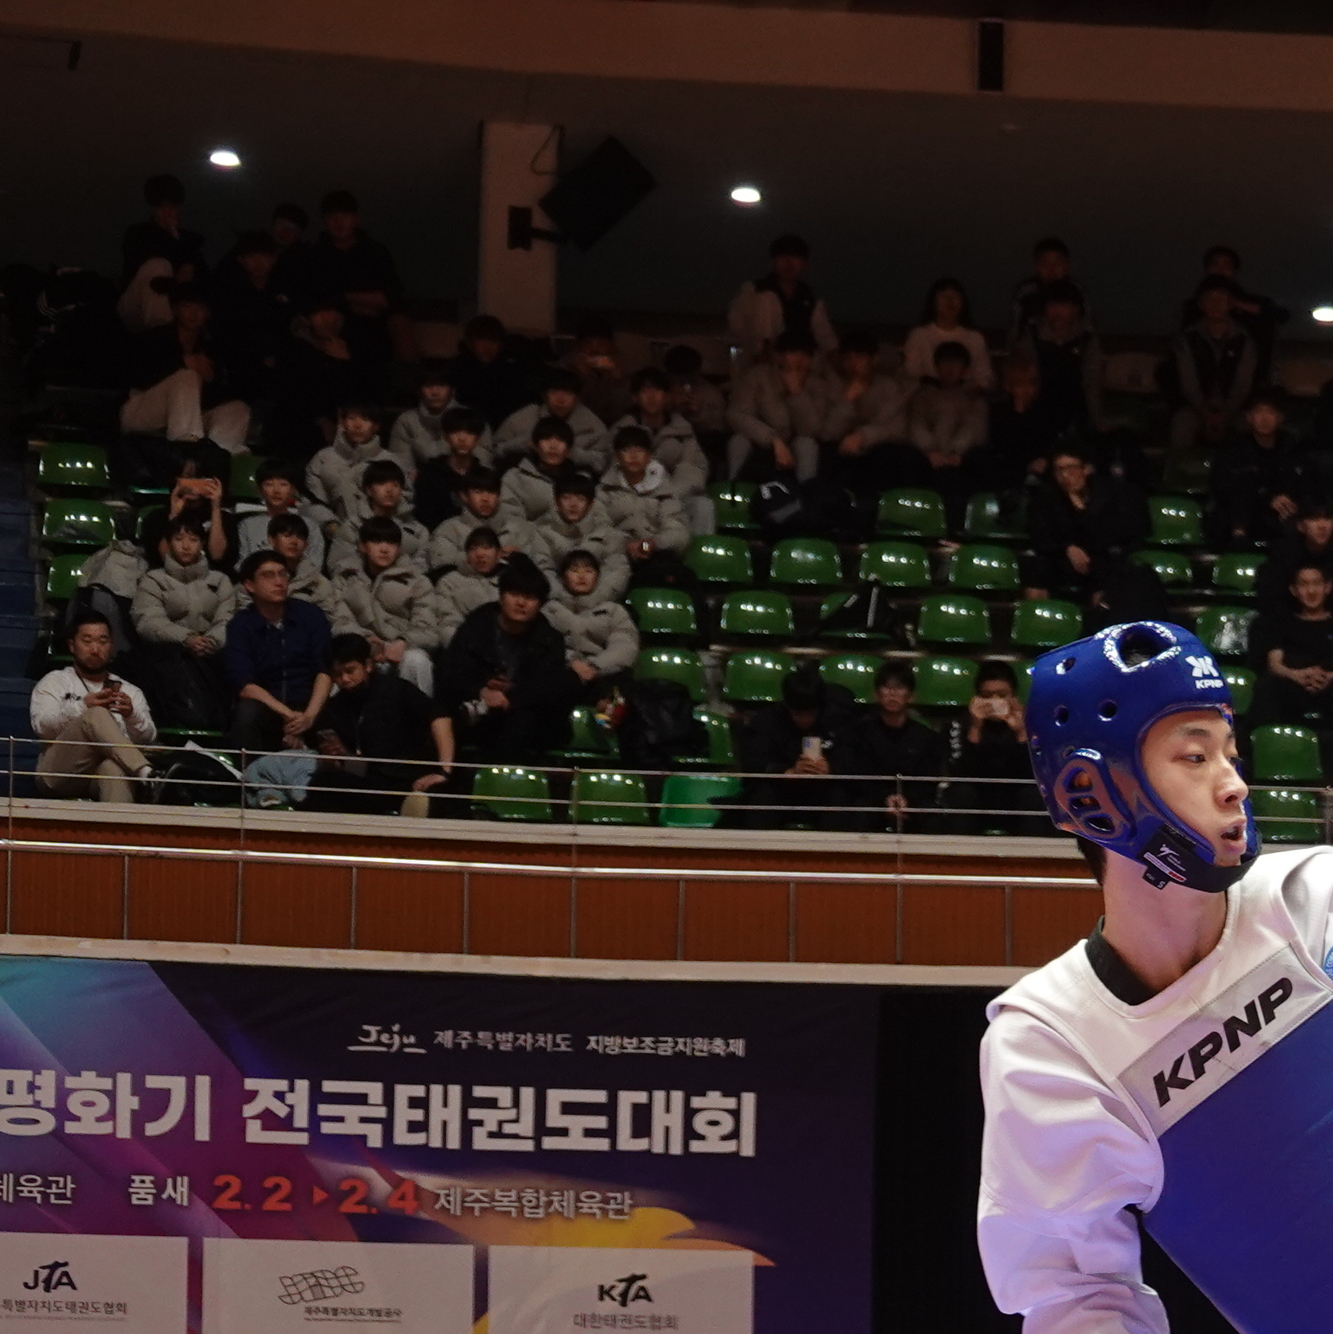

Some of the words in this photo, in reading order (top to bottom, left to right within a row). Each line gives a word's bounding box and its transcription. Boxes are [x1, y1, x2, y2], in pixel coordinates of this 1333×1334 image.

[347, 1023, 428, 1055] Jeju
[433, 1029, 575, 1053] 제주특별자치도
[1153, 977, 1293, 1108] KPNP
[242, 1077, 758, 1158] 전국태권도대회
[434, 1187, 634, 1220] 제주복합체육관
[23, 1260, 78, 1294] JTA
[597, 1273, 654, 1307] KTA
[573, 1312, 680, 1331] 대한태권도협회
